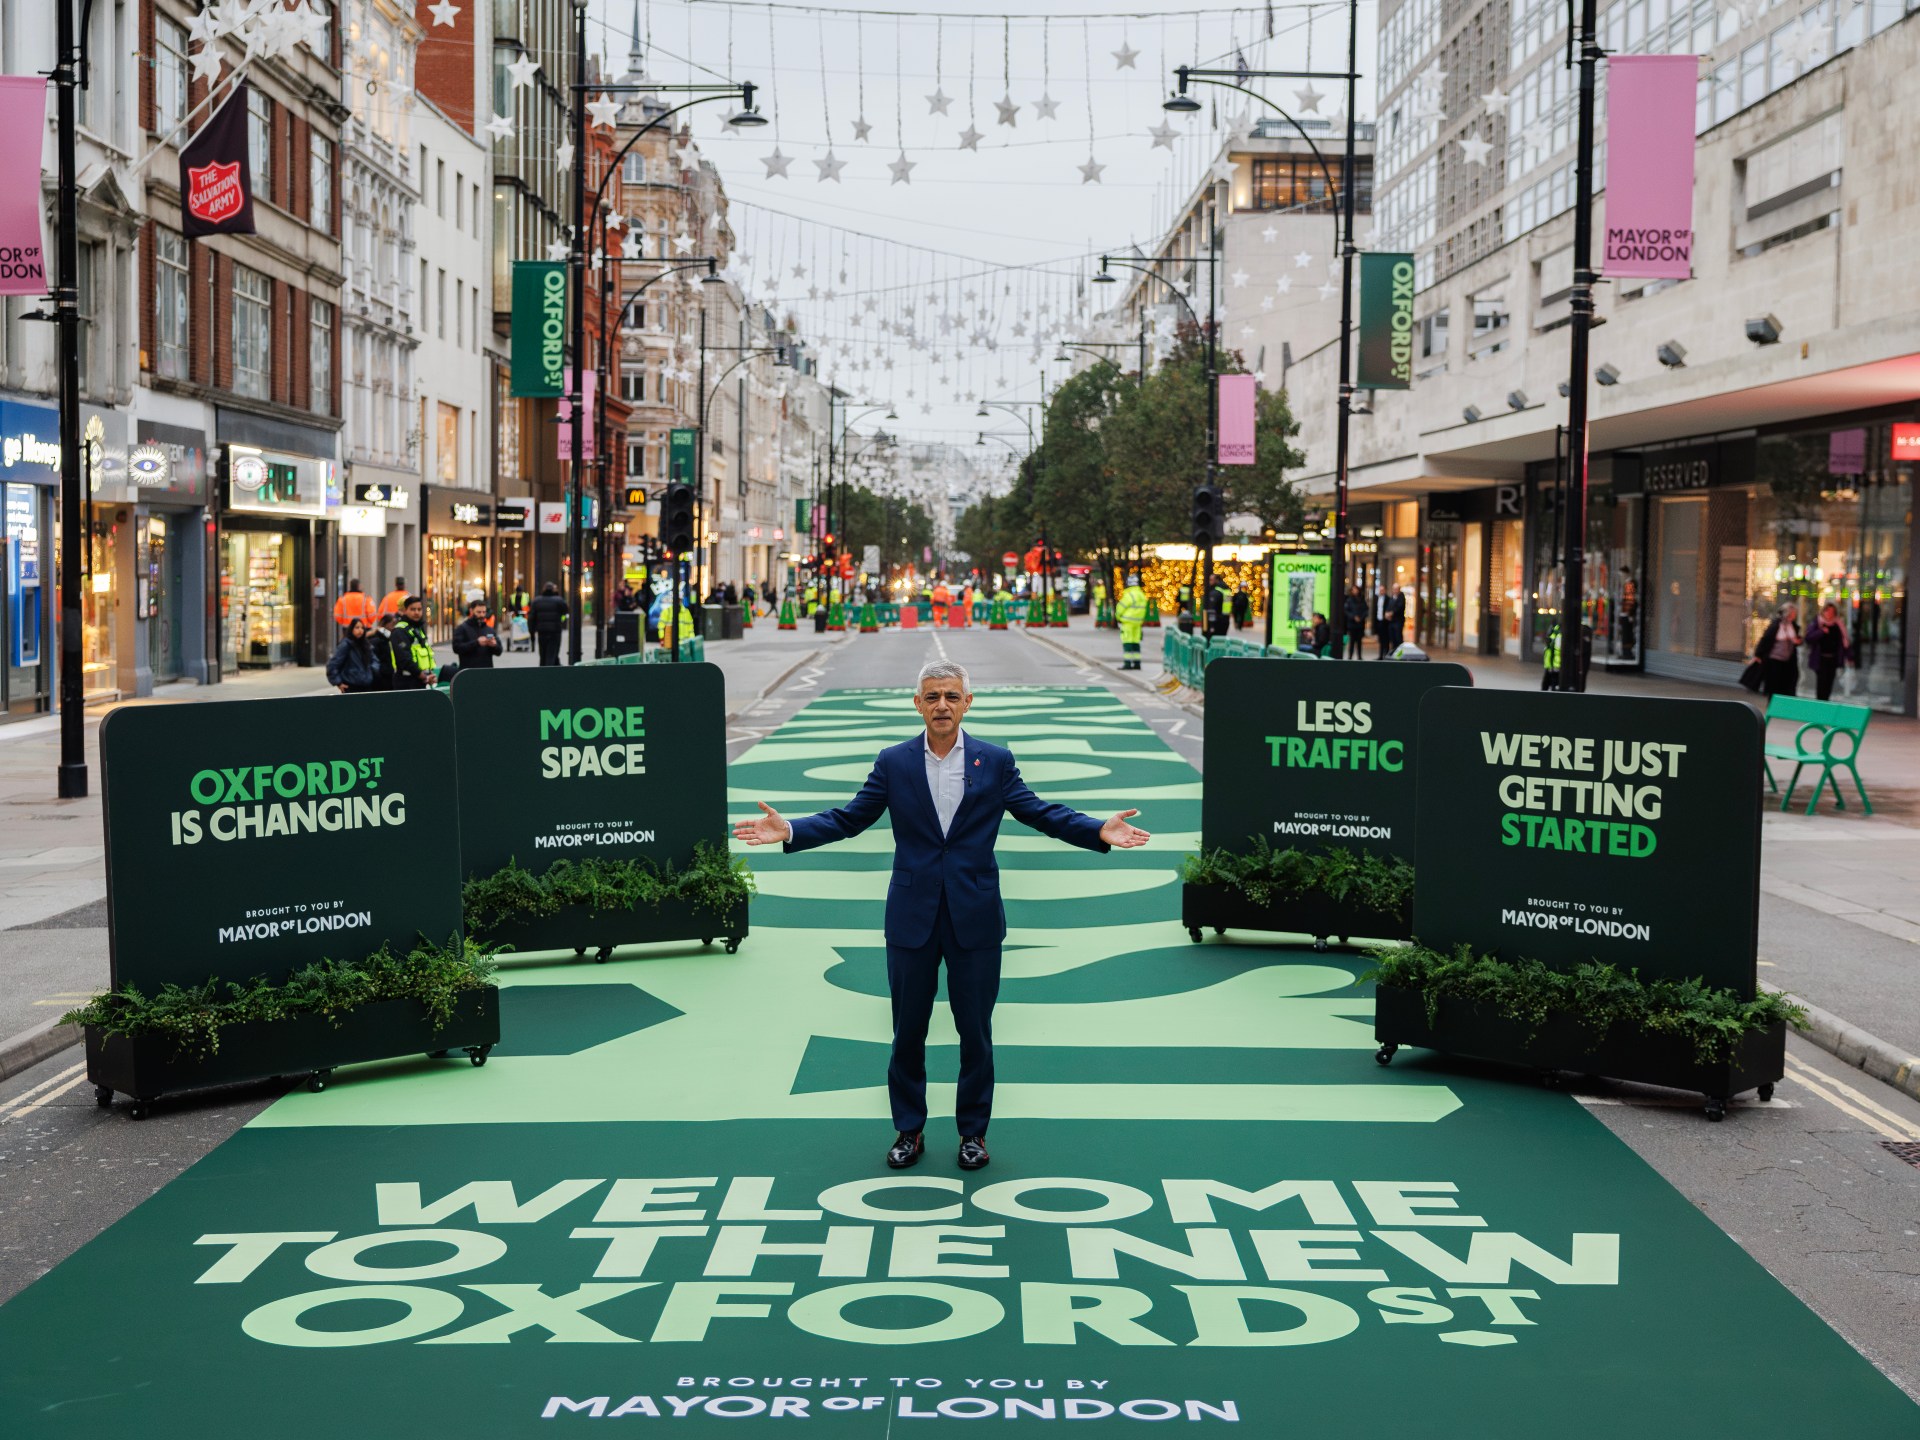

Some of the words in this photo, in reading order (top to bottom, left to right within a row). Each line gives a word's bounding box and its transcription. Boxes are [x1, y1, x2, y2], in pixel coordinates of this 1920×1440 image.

[191, 170, 237, 209] SALVATION
[199, 169, 218, 188] THE
[208, 188, 235, 216] ARMY
[1608, 229, 1671, 245] MAYOR
[1673, 229, 1689, 239] OF
[24, 248, 40, 258] OF
[1607, 245, 1688, 261] LONDON
[1645, 461, 1709, 491] RESERVED
[1277, 563, 1327, 574] COMING
[541, 706, 646, 741] MORE
[1297, 700, 1373, 734] LESS
[541, 743, 646, 779] SPACE
[1265, 735, 1404, 772] TRAFFIC
[1480, 731, 1596, 772] WE’RE
[1602, 740, 1687, 782] JUST
[191, 760, 358, 805] OXFORD
[1500, 774, 1662, 821] GETTING
[172, 810, 203, 846] IS
[209, 793, 406, 842] CHANGING
[556, 823, 591, 831] BROUGHT
[624, 820, 634, 828] BY
[1274, 821, 1319, 836] MAYOR
[1320, 824, 1332, 832] OF
[1333, 825, 1391, 840] LONDON
[1295, 812, 1329, 820] BROUGHT
[1331, 813, 1341, 821] TO
[535, 835, 583, 849] MAYOR
[584, 834, 595, 843] OF
[596, 830, 655, 846] LONDON
[1502, 813, 1658, 858] STARTED
[246, 906, 291, 919] BROUGHT
[294, 904, 308, 913] TO
[311, 902, 330, 911] YOU
[333, 900, 345, 909] BY
[1527, 898, 1570, 910] BROUGHT
[1574, 902, 1588, 912] TO
[1590, 904, 1608, 915] YOU
[1611, 906, 1624, 916] BY
[219, 922, 280, 944] MAYOR
[281, 920, 296, 931] OF
[297, 911, 372, 934] LONDON
[1502, 909, 1559, 930] MAYOR
[1560, 916, 1575, 927] OF
[1575, 918, 1650, 941] LONDON
[376, 1176, 1489, 1227] WELCOME
[193, 1230, 508, 1284] TO
[569, 1225, 1010, 1278] THE
[1066, 1228, 1620, 1285] NEW
[241, 1281, 1361, 1348] OXFORD
[677, 1376, 868, 1388] BROUGHT
[892, 1377, 943, 1388] TO
[965, 1378, 1044, 1389] YOU
[1067, 1379, 1109, 1390] BY
[541, 1396, 811, 1419] MAYOR
[821, 1396, 886, 1411] OF
[897, 1396, 1241, 1422] LONDON
